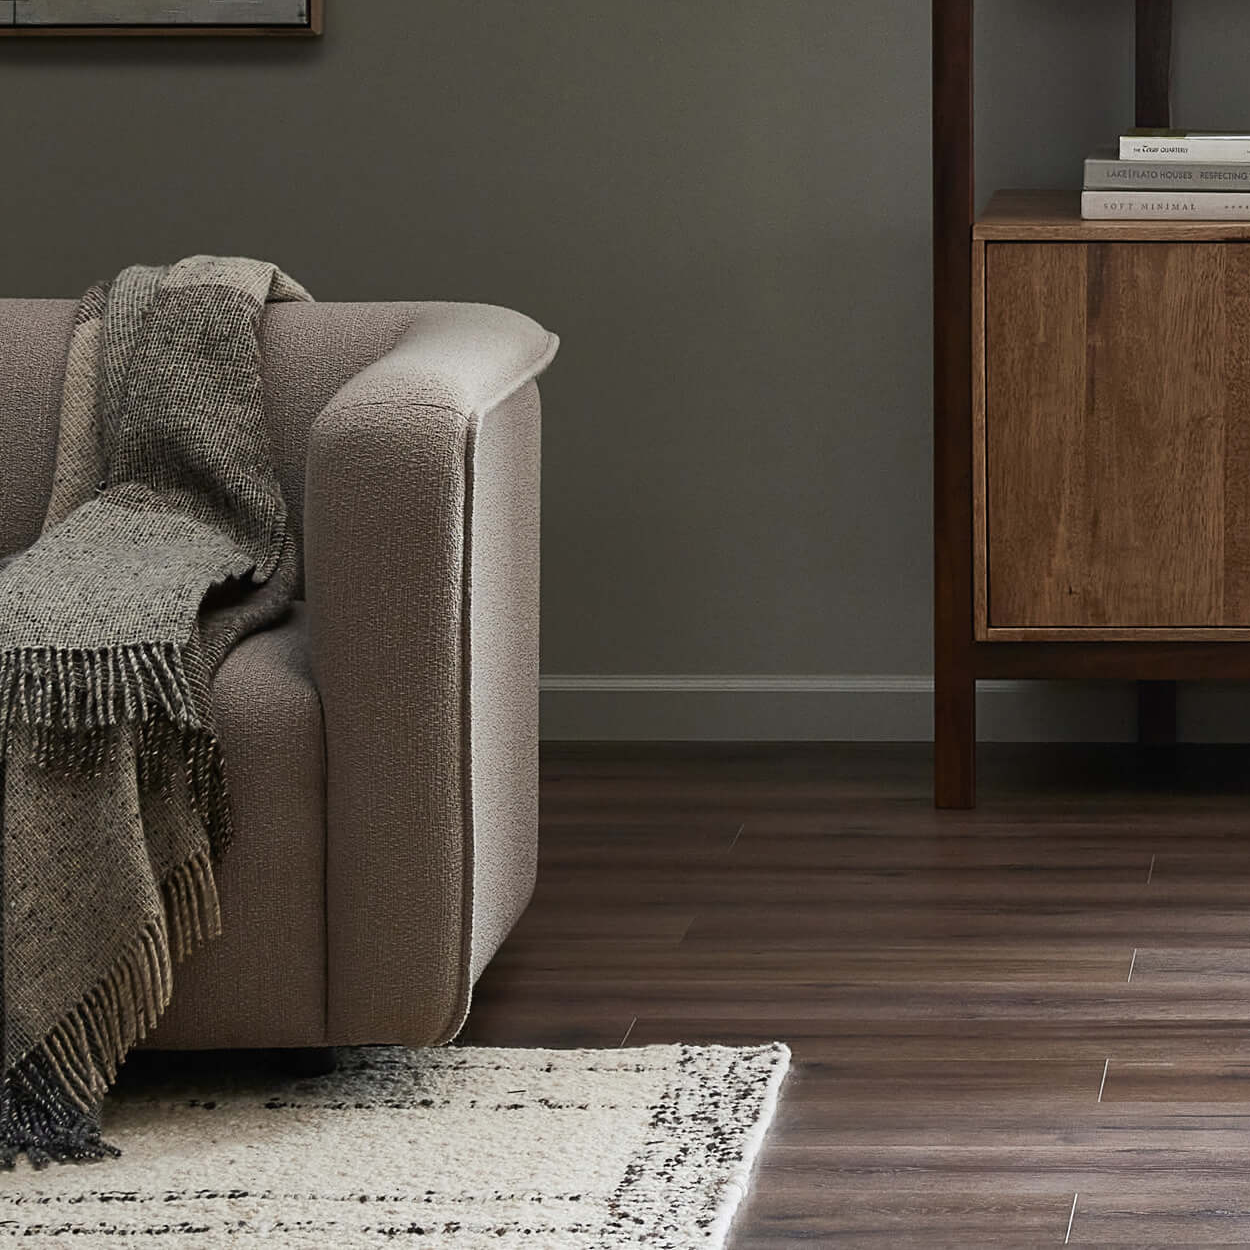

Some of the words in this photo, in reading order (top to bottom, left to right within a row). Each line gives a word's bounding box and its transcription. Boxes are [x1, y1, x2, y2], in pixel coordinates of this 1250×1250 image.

[1160, 171, 1192, 179] HOUSES
[1200, 172, 1247, 180] RESPECTING
[1103, 203, 1133, 211] SOFT
